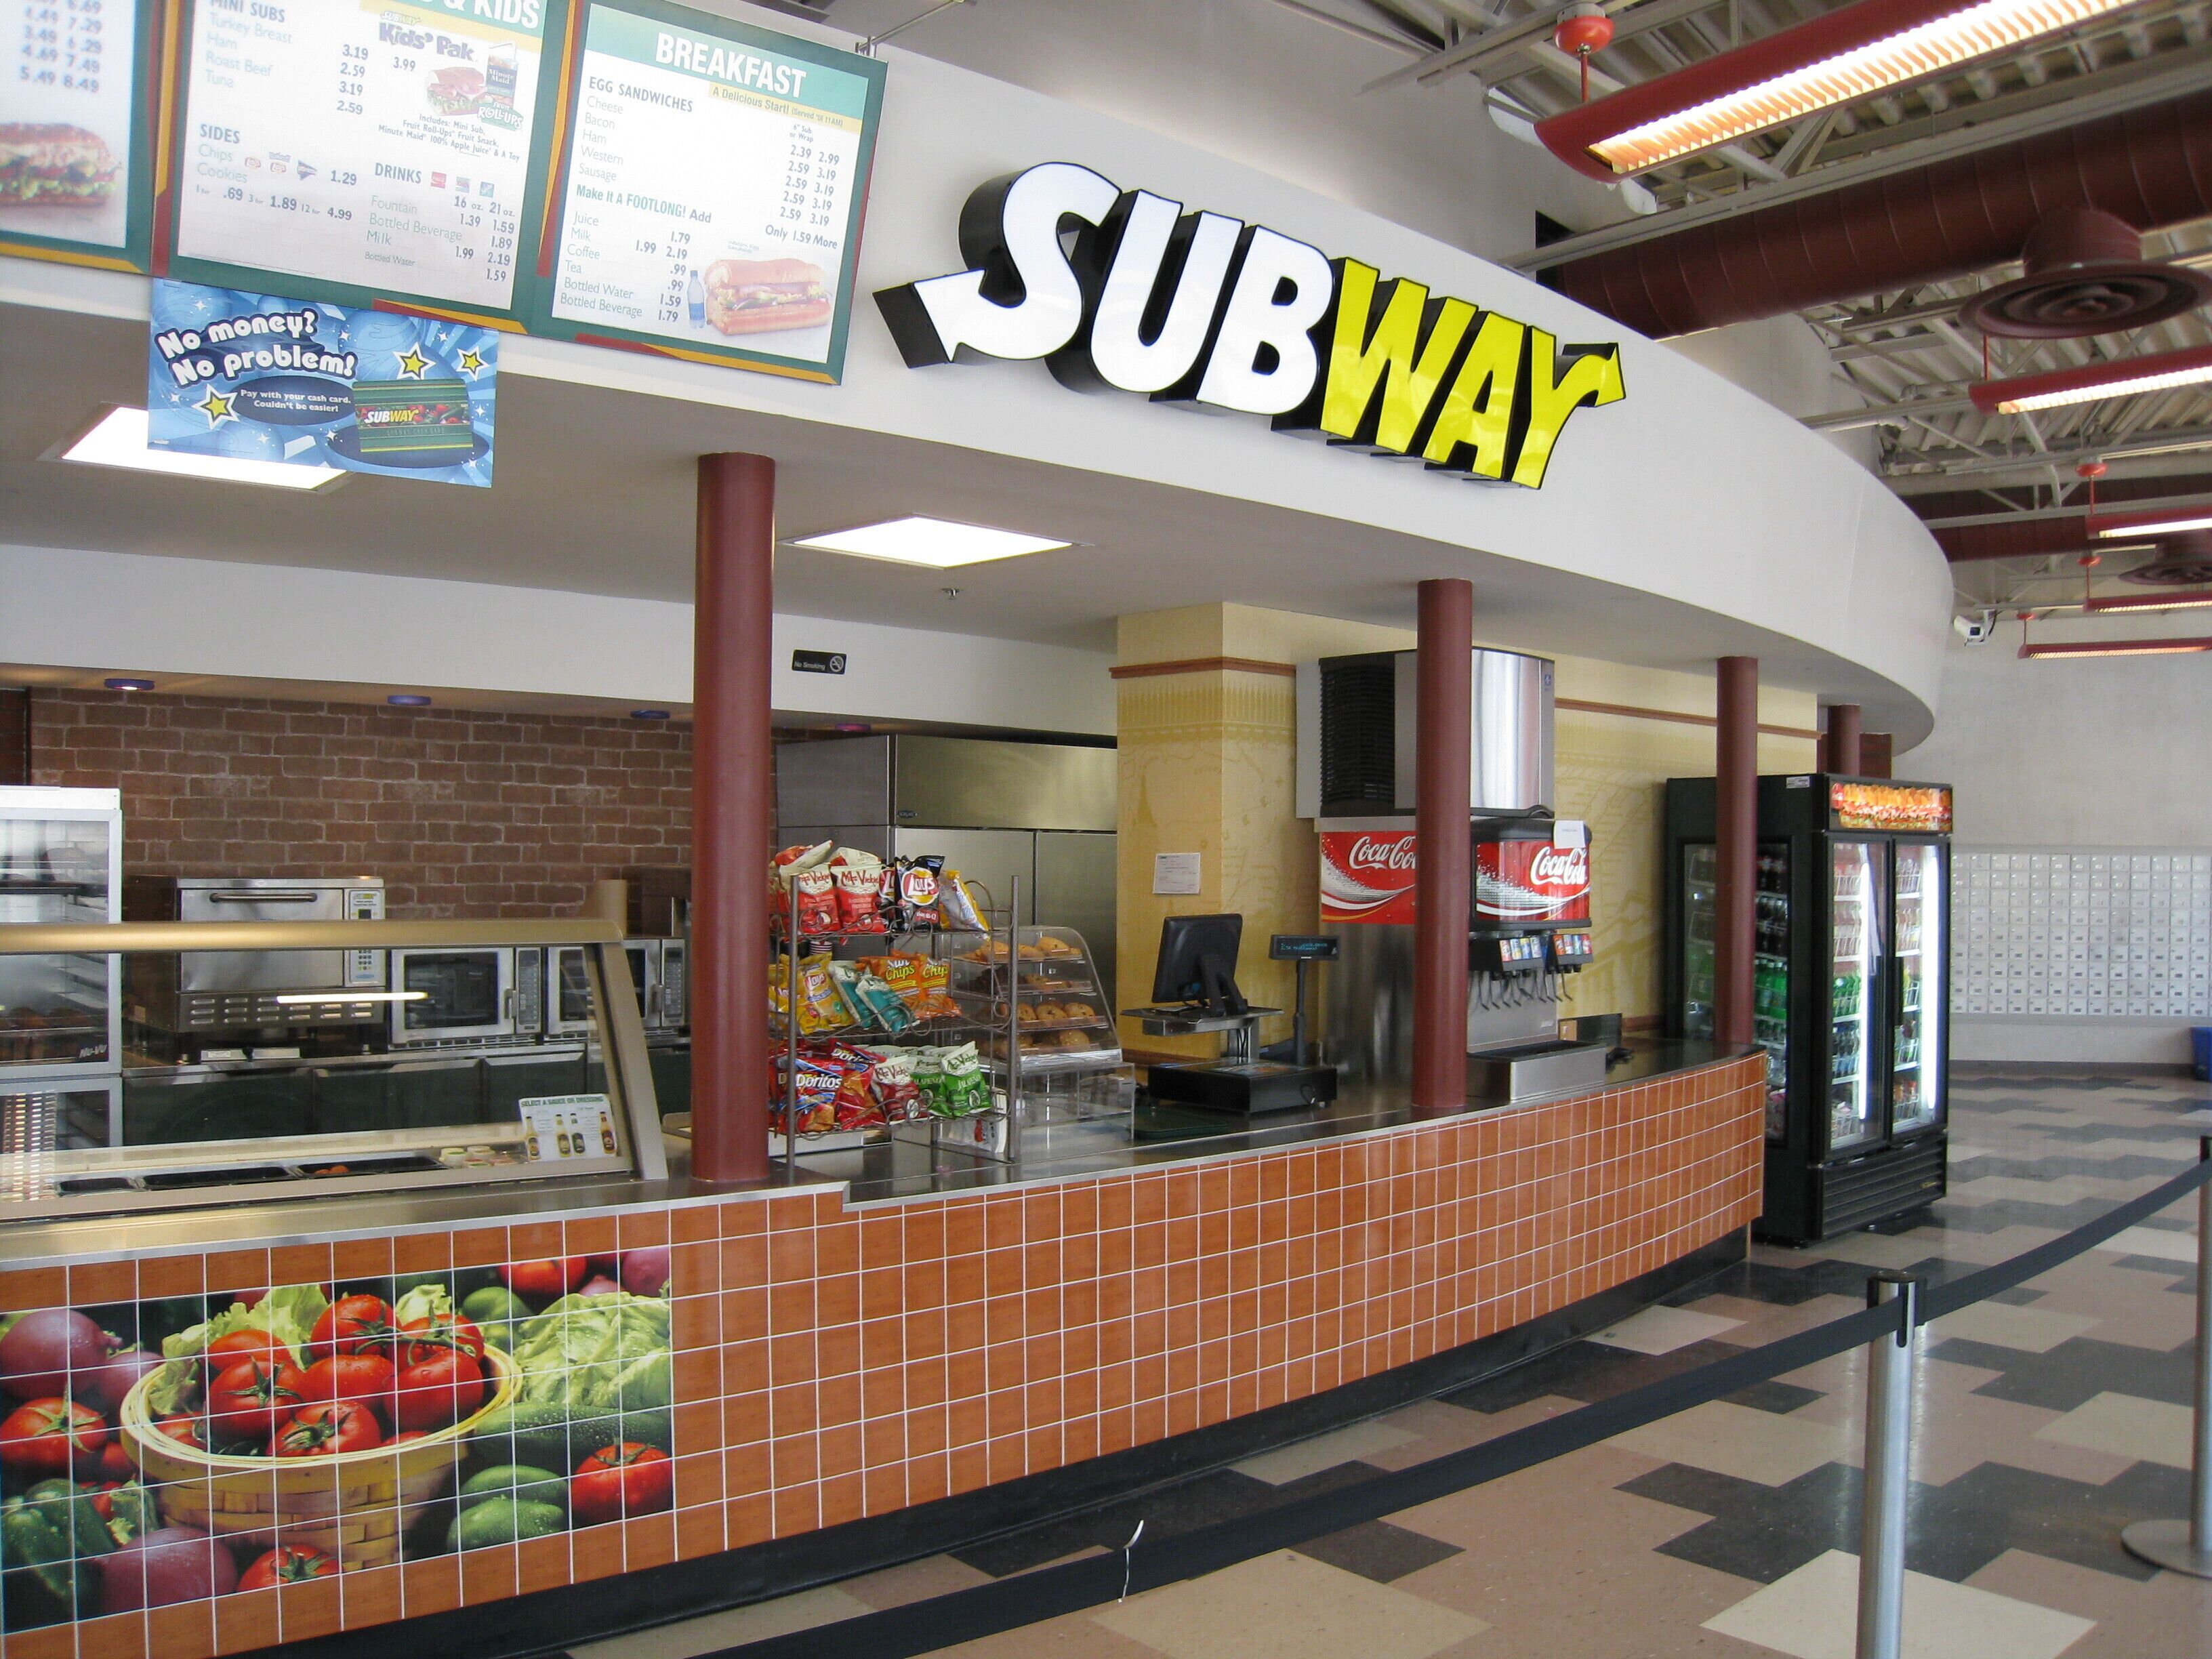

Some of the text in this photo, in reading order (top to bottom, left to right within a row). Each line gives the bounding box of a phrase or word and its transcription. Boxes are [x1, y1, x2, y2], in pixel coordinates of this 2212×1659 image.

[209, 0, 285, 23] MINI SUBS
[381, 11, 423, 26] SUBWAY
[474, 0, 540, 29] KIDS
[209, 12, 293, 44] Turkey Breast
[206, 31, 237, 51] Ham
[437, 35, 474, 62] Pak
[206, 51, 272, 77] Roast Beef
[342, 44, 416, 72] 3.19 3.99
[655, 31, 808, 99] BREAKFAST
[205, 69, 234, 88] Tuna
[340, 62, 366, 79] 2.59
[488, 68, 515, 80] Minute
[490, 75, 510, 85] Maid
[339, 81, 364, 97] 3.19
[588, 75, 694, 112] EGG SANDWICHES
[337, 100, 364, 116] 2.59
[586, 95, 624, 115] Cheese
[712, 86, 719, 96] A
[722, 88, 763, 109] Delicious
[764, 99, 790, 116] Start!
[403, 119, 420, 131] Fruit
[458, 131, 475, 142] Fruit
[419, 113, 451, 127] Includes:
[453, 121, 470, 131] Mini
[585, 111, 615, 130] Bacon
[801, 125, 813, 135] Sub
[199, 123, 241, 145] SIDES
[379, 124, 404, 137] Minute
[430, 134, 449, 146] 100%
[451, 140, 471, 152] Apple
[501, 150, 507, 159] A
[509, 152, 520, 164] Toy
[581, 128, 607, 145] Ham
[798, 132, 814, 144] Wrap
[199, 144, 233, 163] Chips
[580, 144, 624, 166] Western
[790, 144, 840, 167] 2.39 2.99
[197, 162, 248, 184] Cookies
[330, 169, 358, 186] 1.29
[374, 162, 423, 185] DRINKS
[578, 162, 617, 184] Sausage
[787, 160, 837, 182] 2.59 3.19
[785, 175, 834, 197] 2.59 3.19
[223, 186, 245, 201] .69
[270, 194, 298, 211] 1.89
[300, 203, 311, 213] 12
[327, 206, 352, 222] 4.99
[371, 194, 418, 216] Fountain
[453, 195, 467, 209] 16
[489, 201, 501, 216] 21
[575, 184, 604, 202] Make
[615, 193, 623, 205] A
[626, 193, 687, 219] FOOTLONG!
[689, 209, 712, 224] Add
[782, 190, 832, 212] 2.59 3.19
[459, 213, 516, 234] 1.39 1.59
[572, 210, 600, 227] Juice
[779, 206, 830, 228] 2.59 3.19
[366, 229, 392, 247] Milk
[369, 212, 462, 244] Bottled Beverage
[570, 226, 592, 243] Milk
[670, 230, 691, 245] 1.79
[764, 224, 839, 250] Only 1.59 More
[491, 234, 513, 251] 1.89
[567, 243, 601, 261] Coffee
[635, 239, 689, 260] 1.99 2.19
[364, 250, 392, 263] Bottled
[455, 245, 511, 266] 1.99 2.19
[486, 267, 507, 283] 1.59
[565, 259, 582, 274] Tea
[669, 263, 687, 276] .99
[563, 276, 634, 300] Bottled Water
[667, 279, 684, 293] .99
[560, 291, 643, 321] Bottled Beverage
[659, 293, 682, 308] 1.59
[657, 309, 680, 323] 1.79
[912, 161, 1627, 490] SUBWAY
[158, 310, 316, 360] No money?
[171, 344, 355, 387] No problem!
[240, 388, 258, 400] Pay
[260, 390, 283, 400] with
[307, 394, 328, 403] cash
[329, 396, 352, 405] card.
[253, 399, 340, 413] Couldn't be easier!
[364, 409, 420, 424] SUBWAY
[1530, 846, 1587, 885] Coca-Cola
[886, 964, 916, 981] Chips
[923, 964, 948, 979] Chip
[796, 1073, 843, 1089] Doritos
